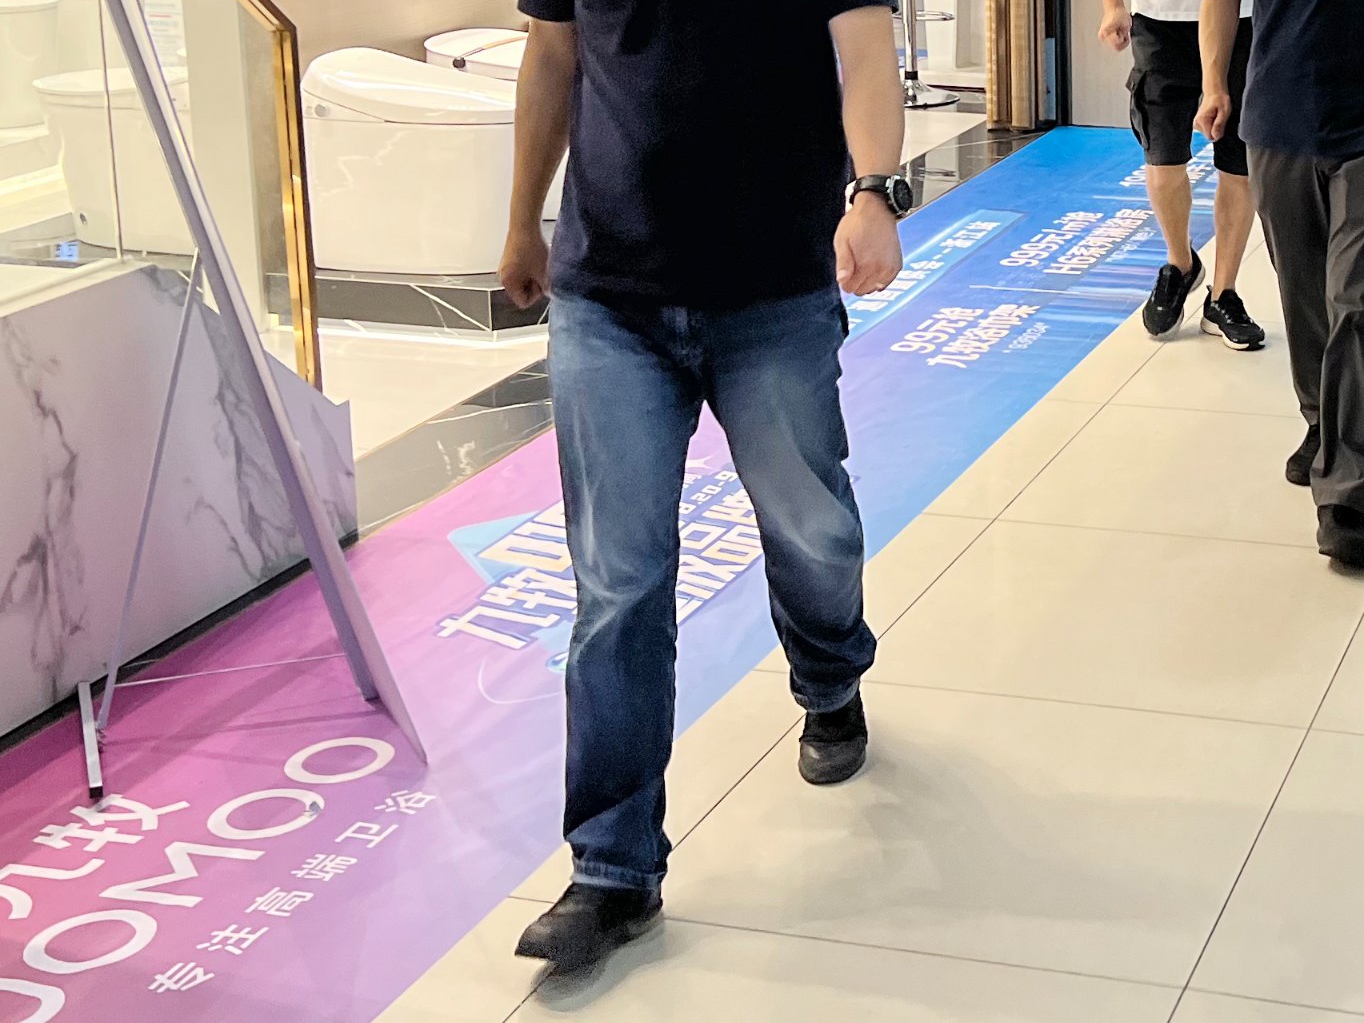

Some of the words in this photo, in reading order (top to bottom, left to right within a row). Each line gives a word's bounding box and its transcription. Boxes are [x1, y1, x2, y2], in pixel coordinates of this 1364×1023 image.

[889, 306, 985, 354] 99元抢
[926, 303, 1041, 369] 九牧浴巾架
[148, 787, 438, 996] 专注高端卫浴
